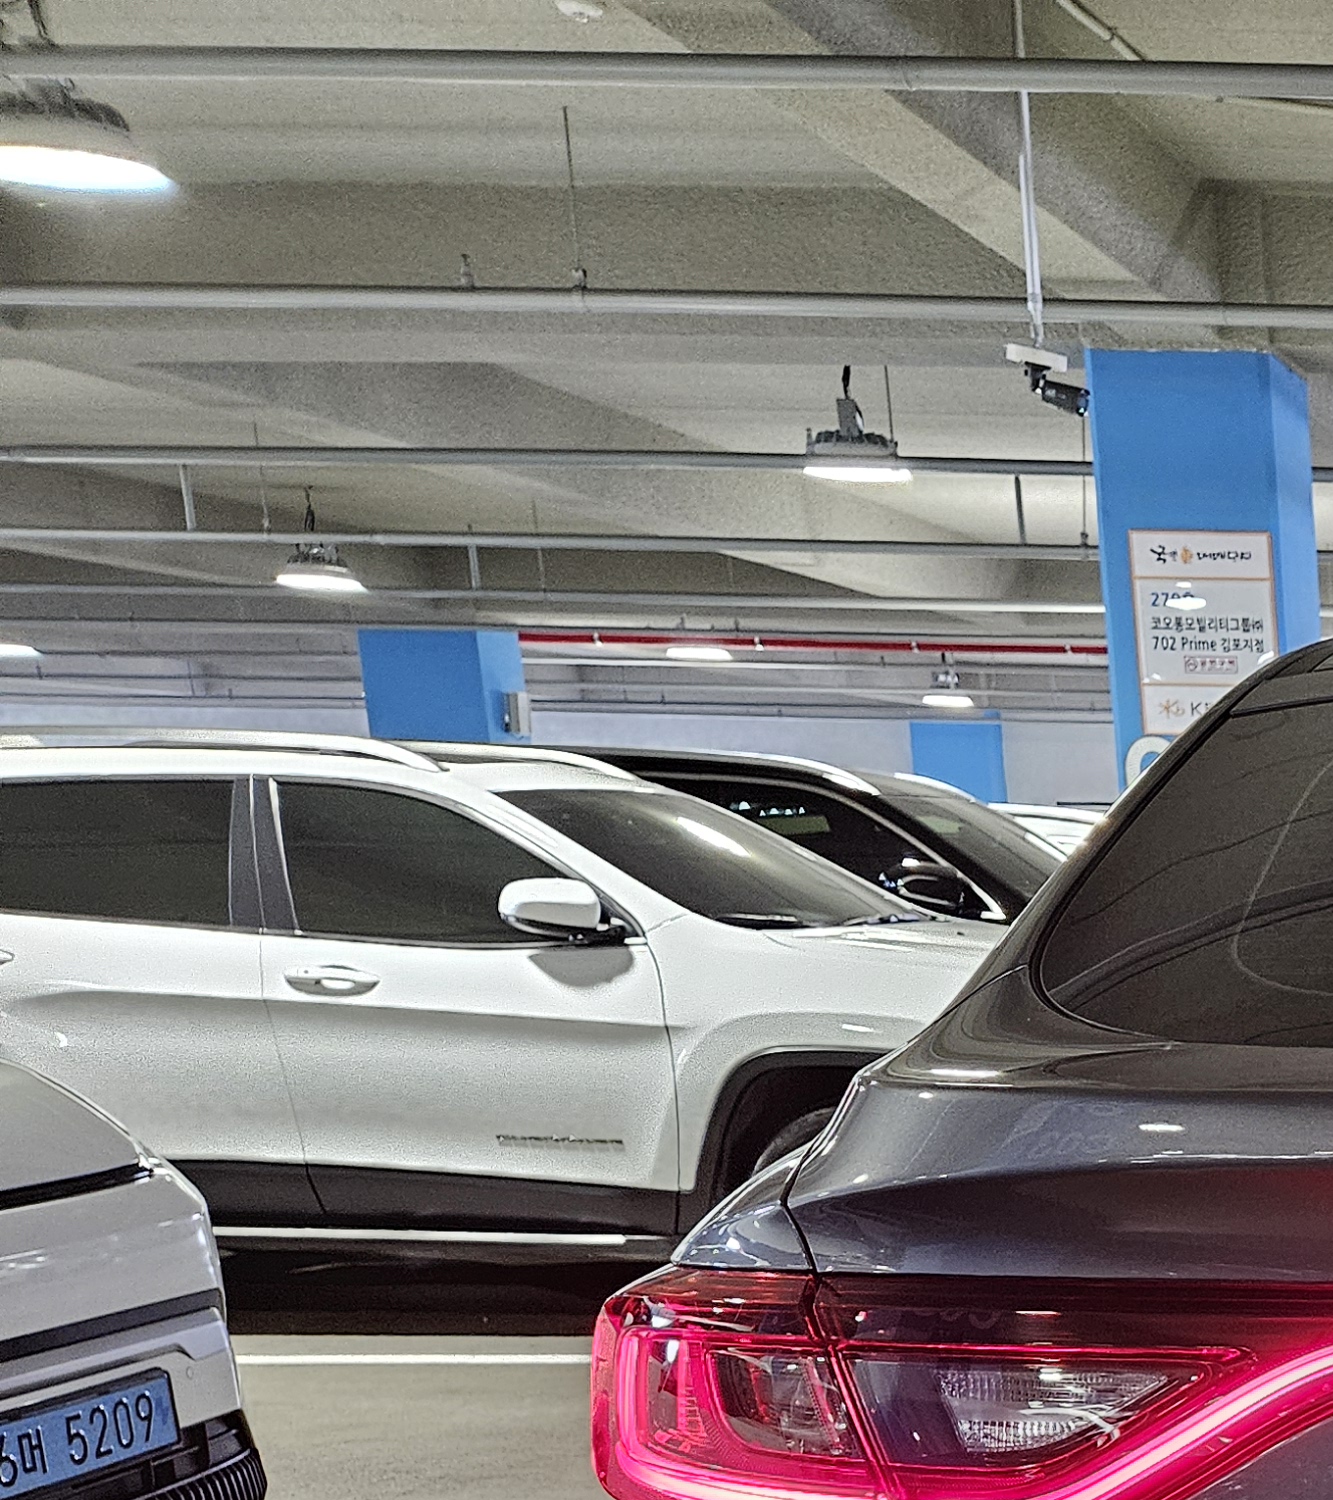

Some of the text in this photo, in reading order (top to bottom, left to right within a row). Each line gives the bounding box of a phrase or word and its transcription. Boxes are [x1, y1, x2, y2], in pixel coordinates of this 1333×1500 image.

[1152, 635, 1265, 653] 702 Prime 김포지점
[65, 1390, 155, 1465] 5209
